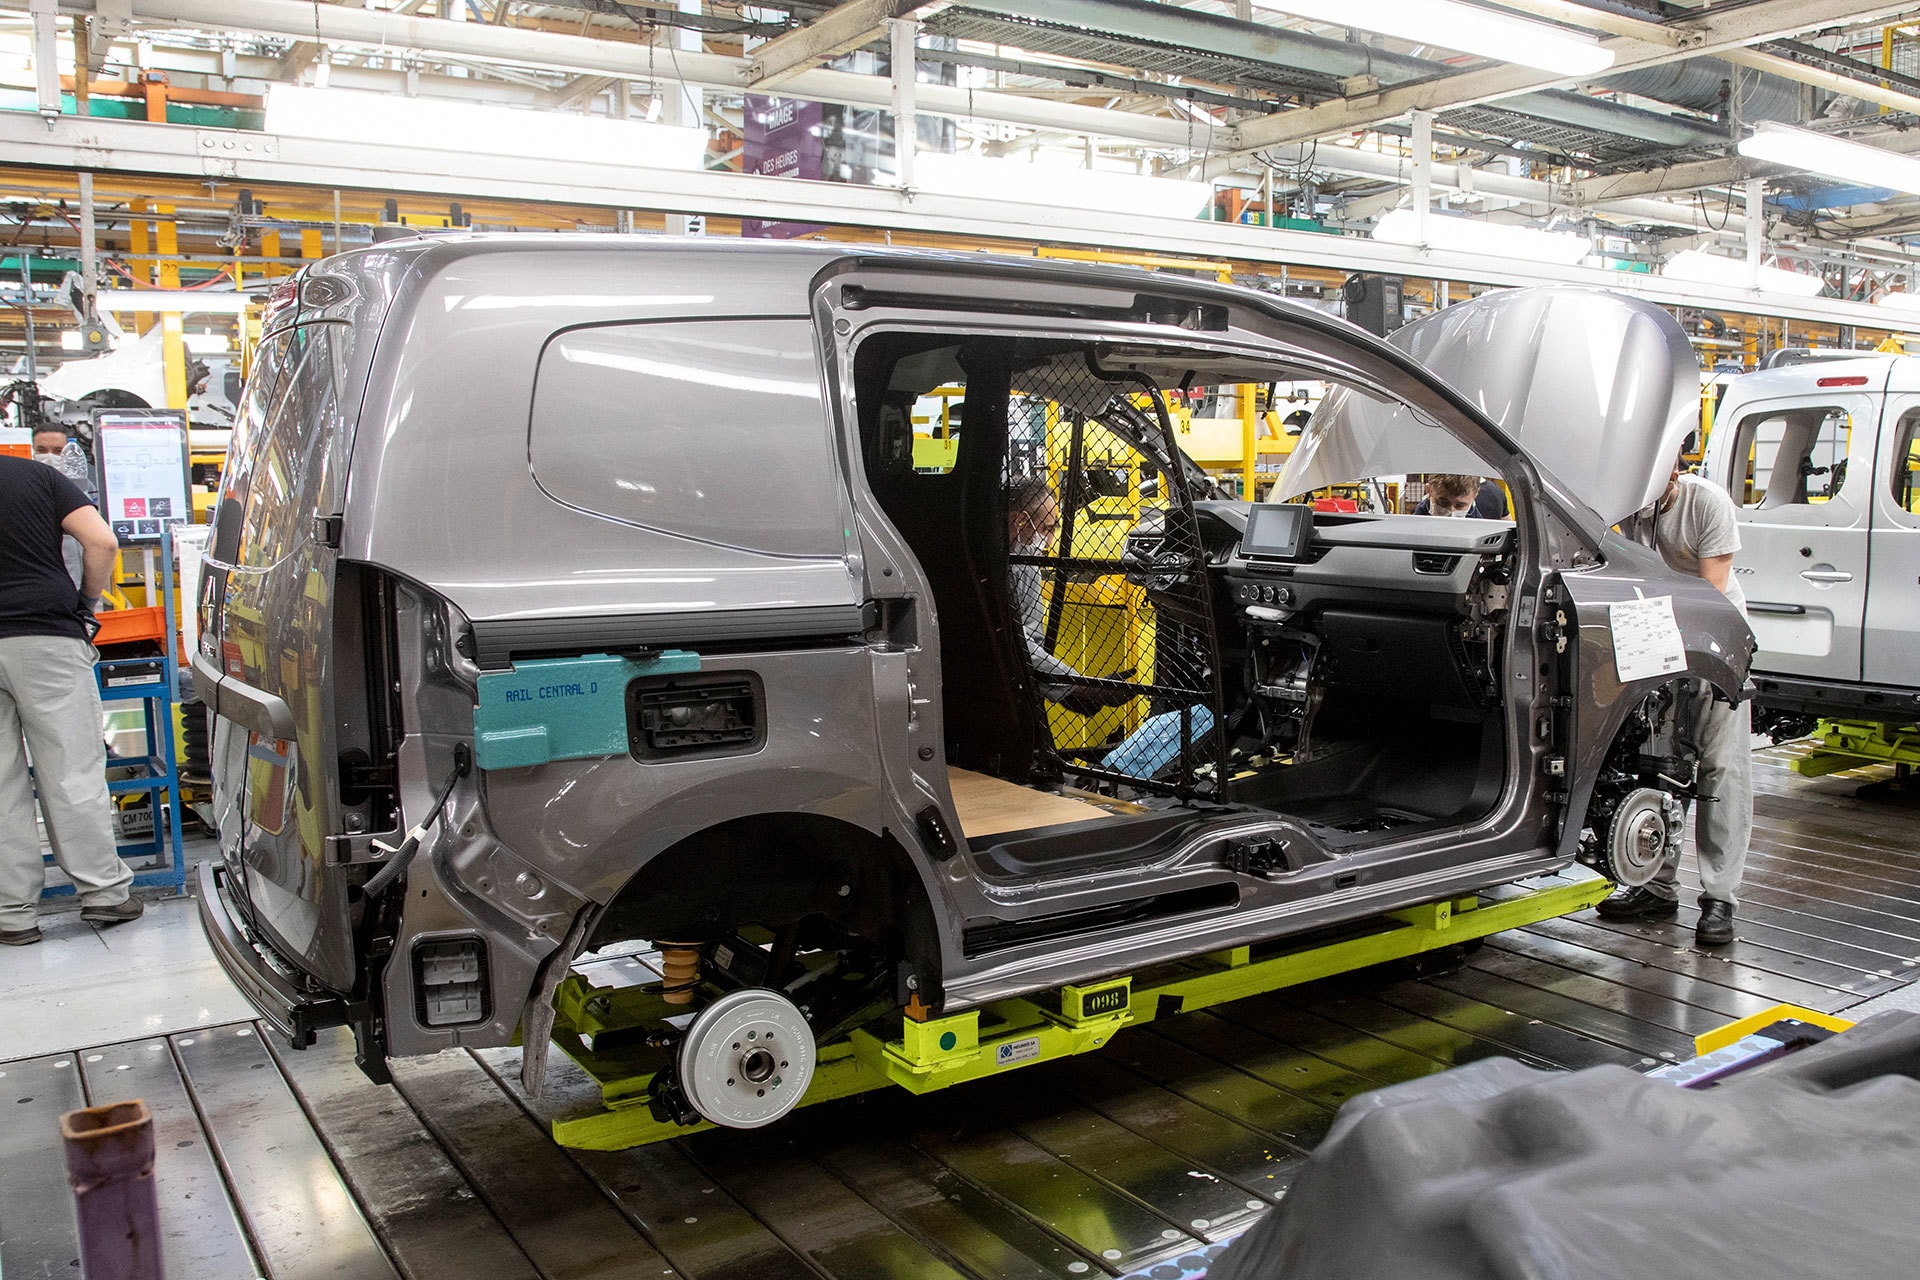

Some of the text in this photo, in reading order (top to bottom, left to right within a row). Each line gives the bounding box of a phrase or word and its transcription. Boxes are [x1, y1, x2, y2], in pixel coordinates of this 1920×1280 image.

[763, 150, 798, 174] DES HEURES
[1180, 419, 1190, 434] 34
[506, 681, 598, 703] RAIL CENTRAL D
[122, 813, 137, 825] CM
[1091, 992, 1120, 1011] 098
